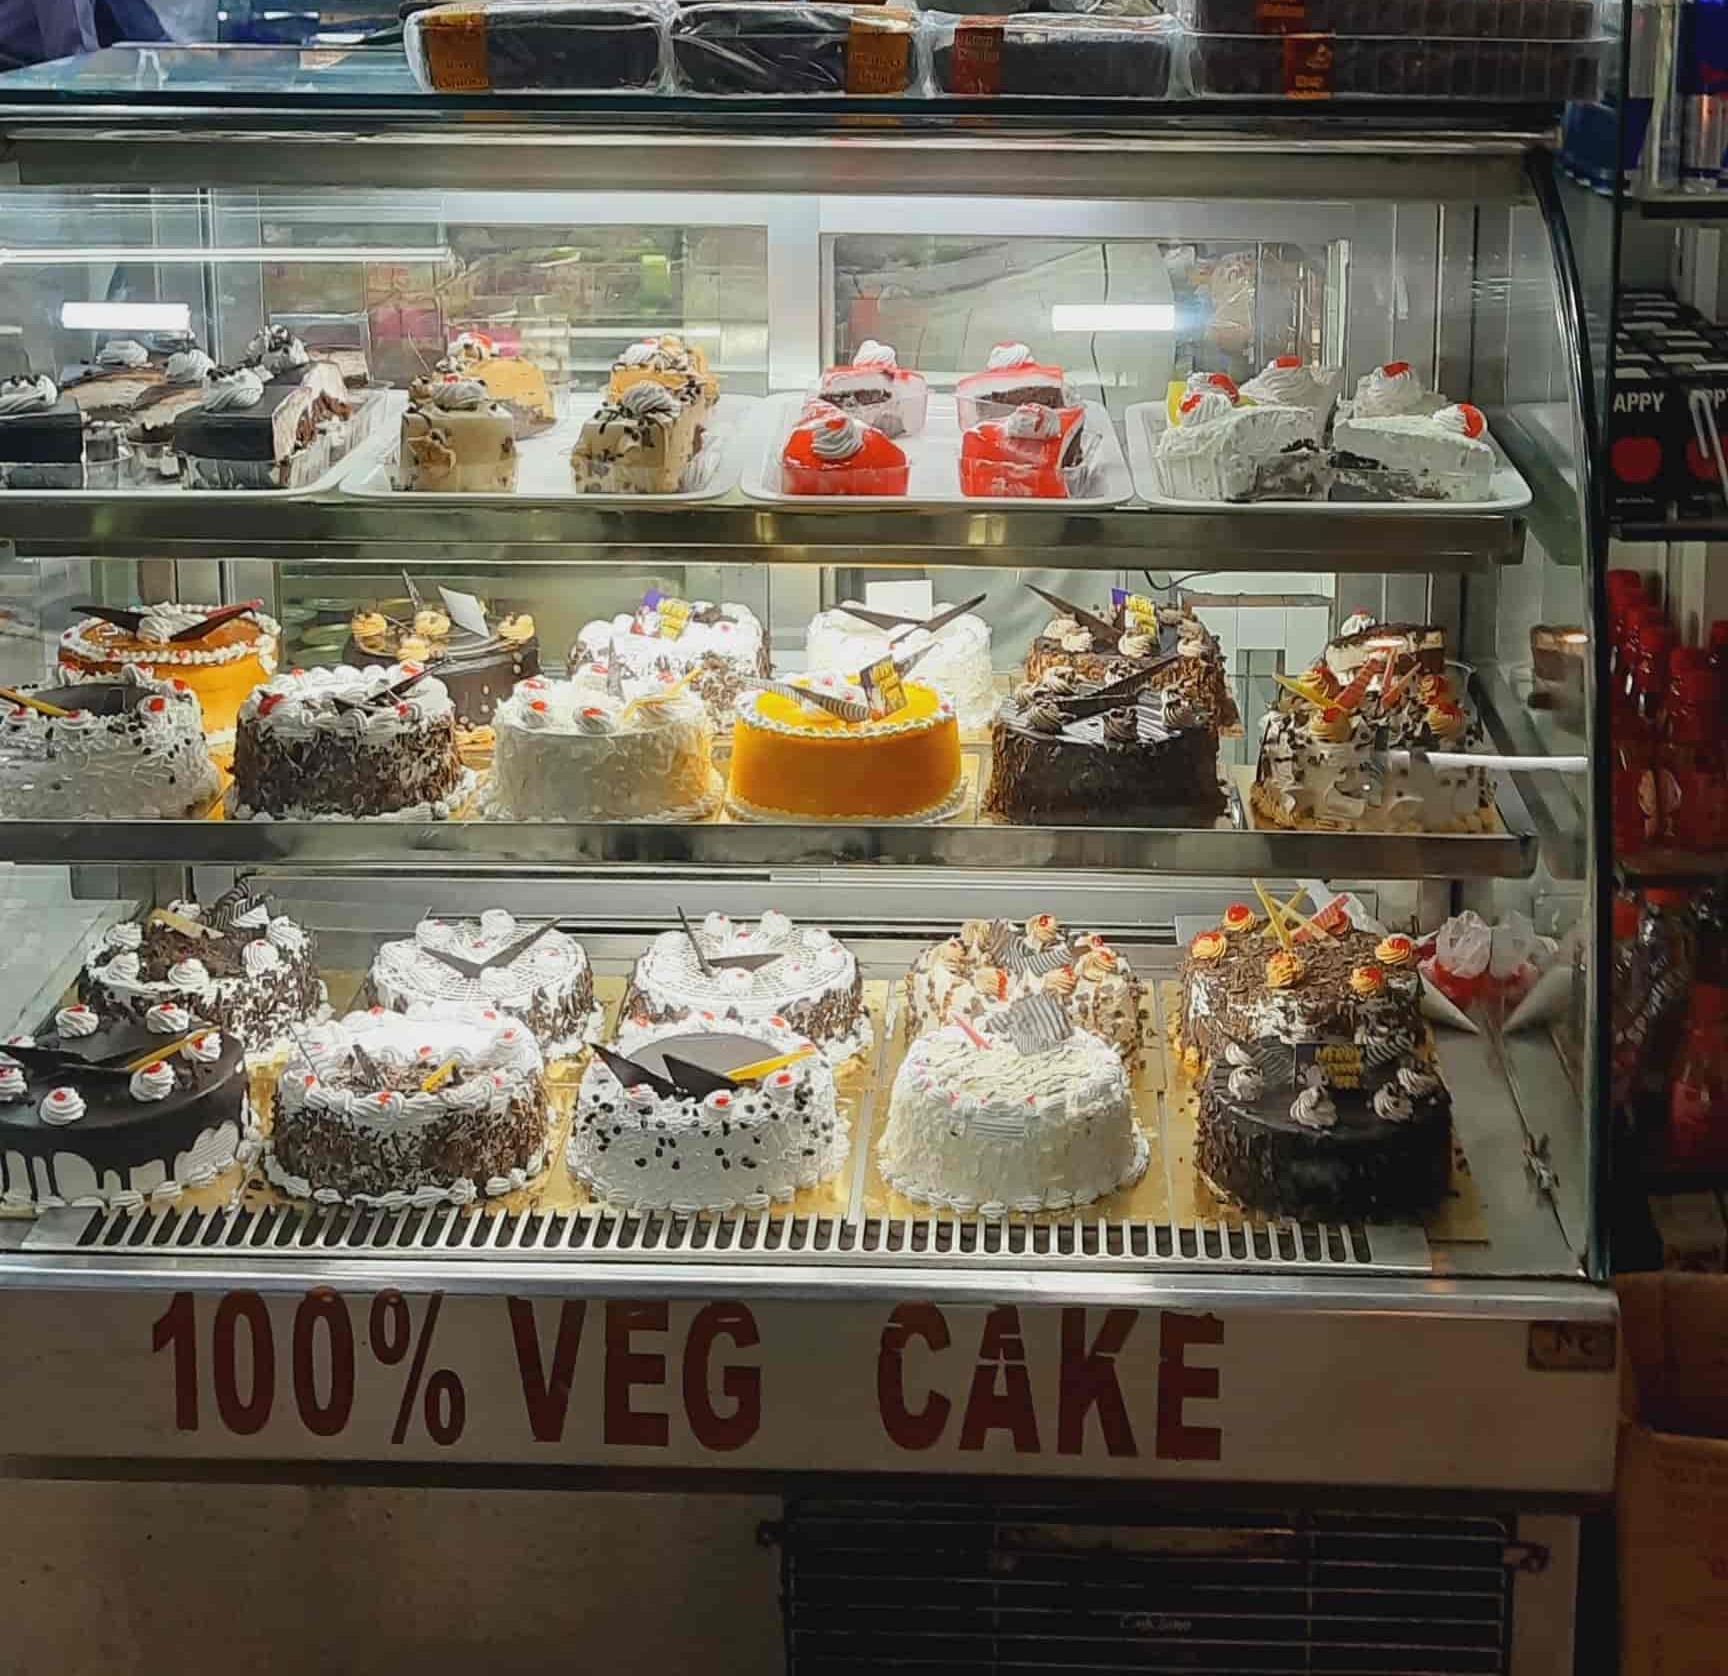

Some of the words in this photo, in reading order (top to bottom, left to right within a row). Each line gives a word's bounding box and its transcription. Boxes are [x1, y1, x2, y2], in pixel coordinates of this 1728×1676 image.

[1613, 391, 1664, 413] APPY
[152, 1287, 466, 1446] 100%
[506, 1295, 762, 1452] VEG
[878, 1300, 1225, 1461] CAKE
